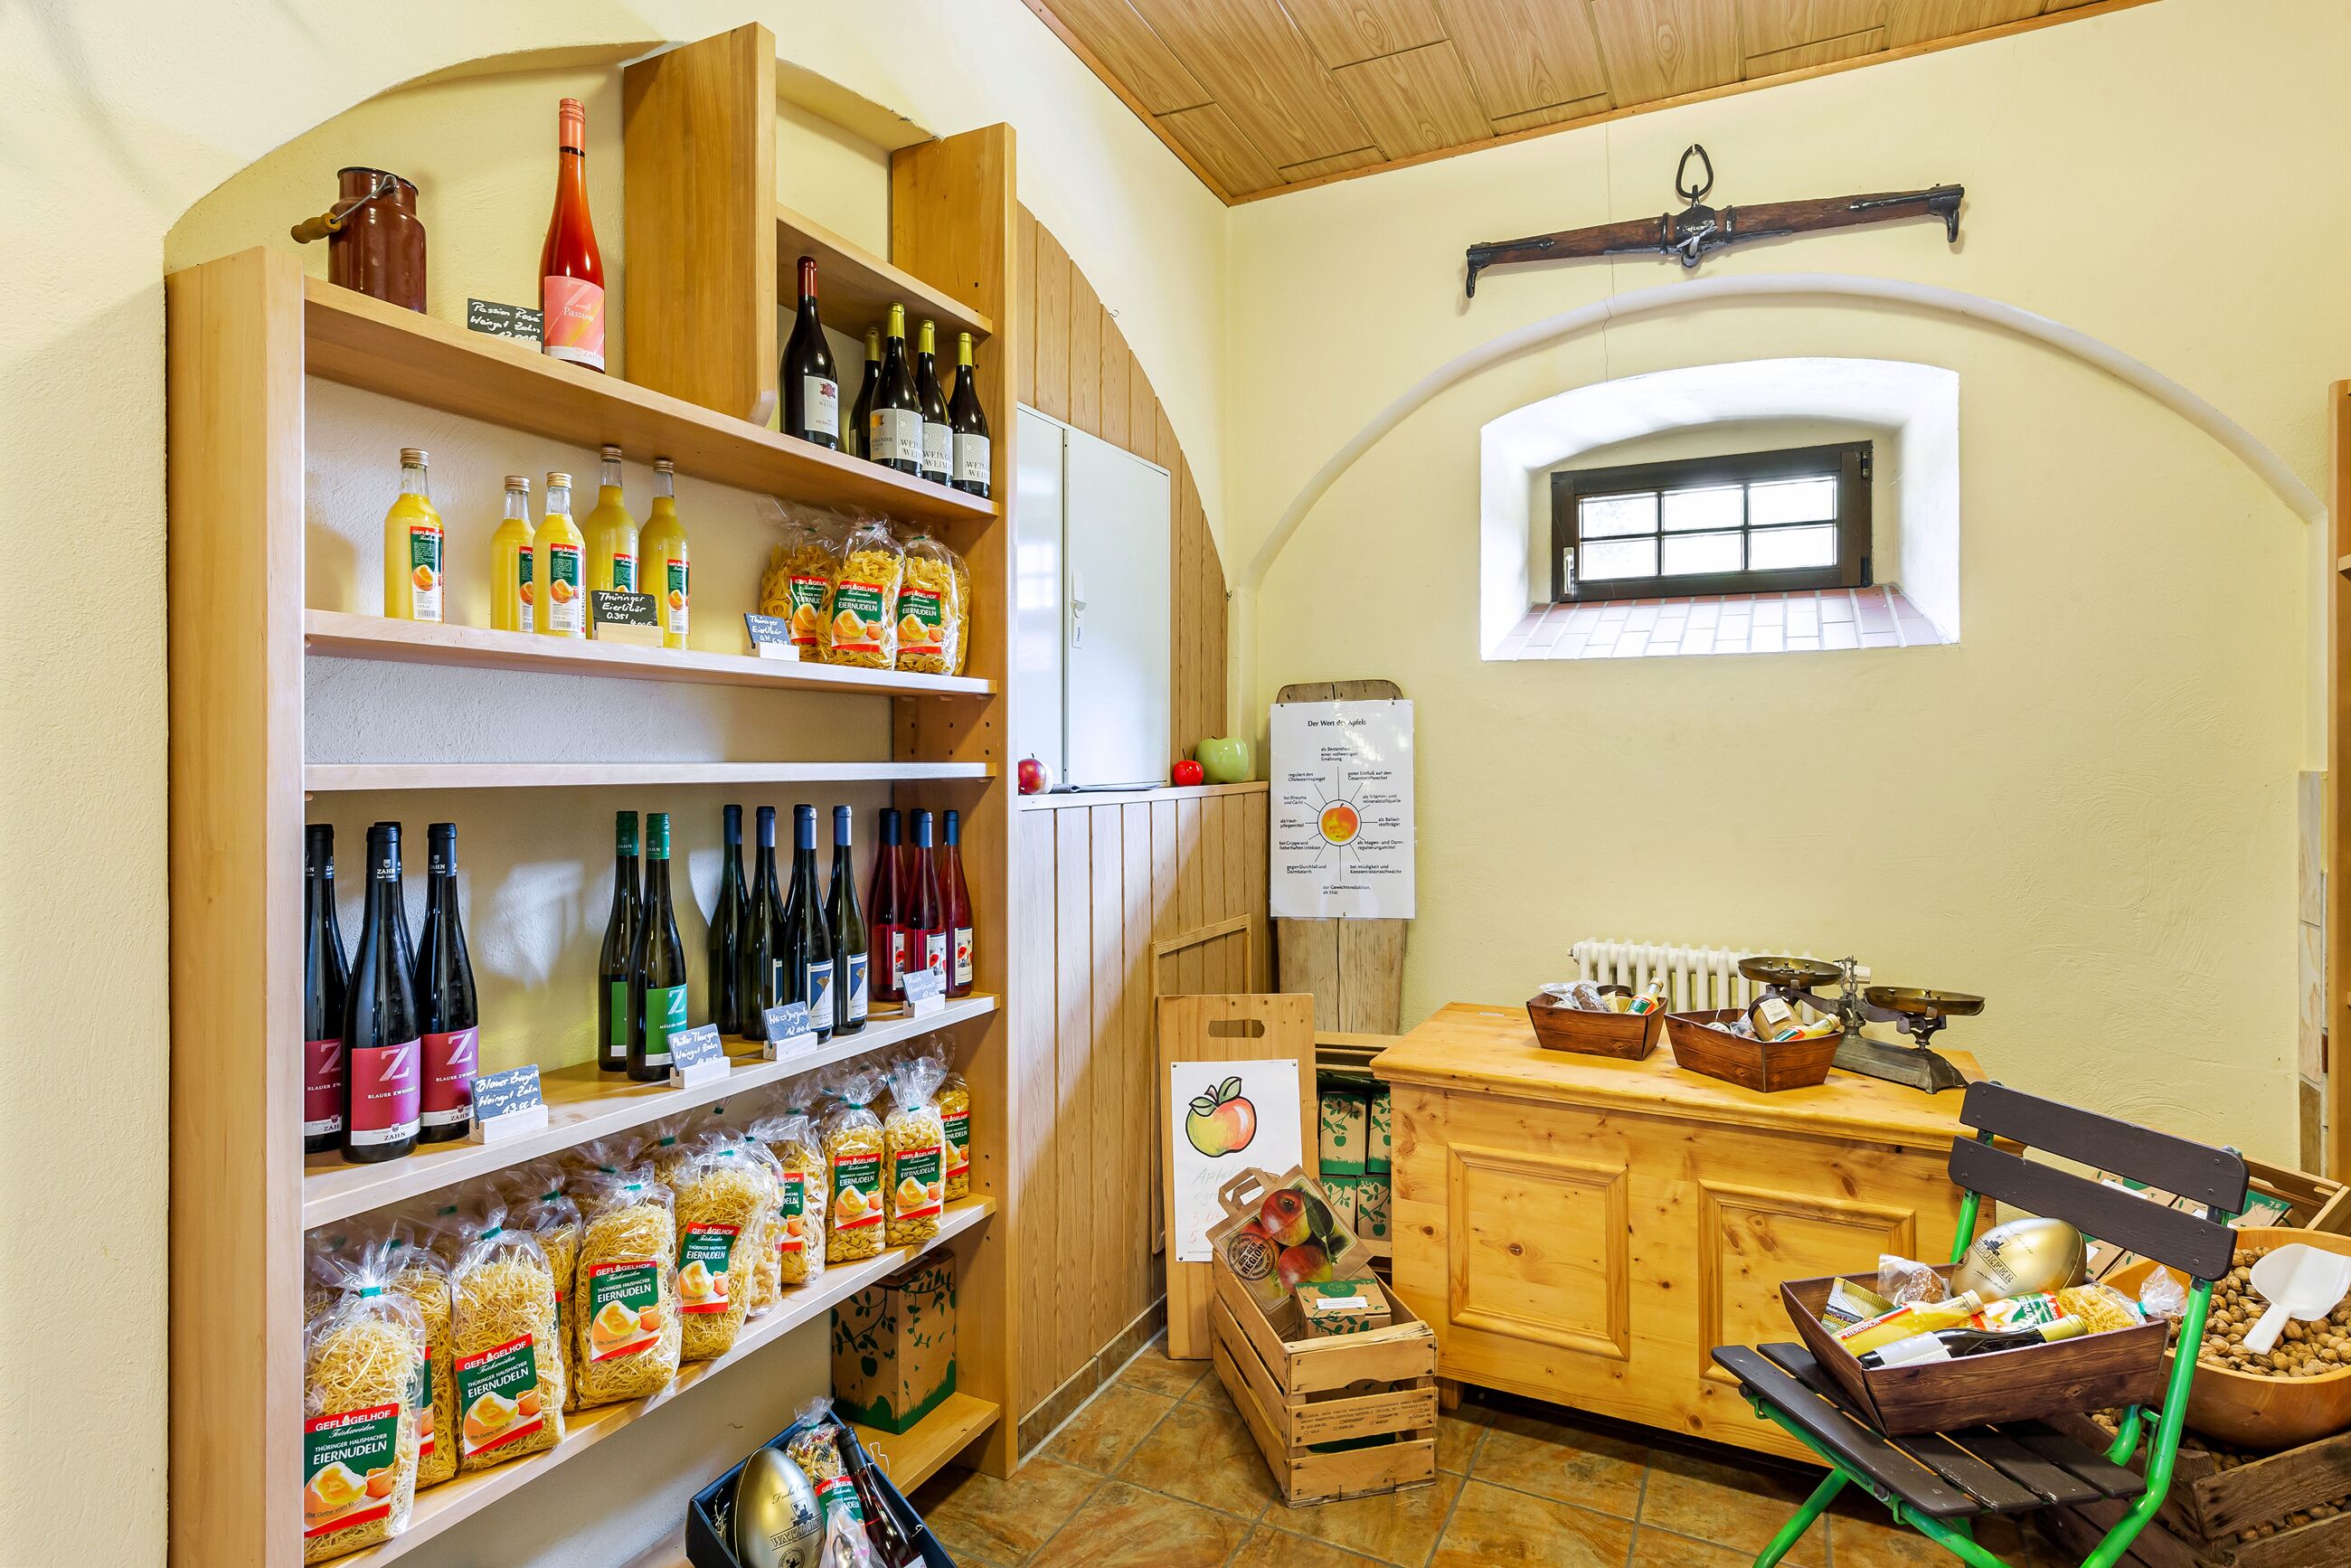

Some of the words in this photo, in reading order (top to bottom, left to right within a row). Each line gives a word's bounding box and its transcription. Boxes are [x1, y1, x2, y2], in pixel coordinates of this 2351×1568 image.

[472, 302, 510, 316] Passion
[515, 307, 543, 323] Rosé
[563, 307, 594, 322] Passion
[469, 316, 510, 331] Weingut
[514, 322, 541, 334] Zahn
[599, 591, 645, 605] Thüringer
[602, 602, 647, 613] Eierlikör
[838, 602, 878, 611] EIERNUDELN
[902, 608, 937, 617] EIERNUDELN
[1348, 719, 1366, 727] Apfels
[668, 987, 685, 1015] Z
[447, 1032, 472, 1065] Z
[675, 1048, 701, 1060] Weingut
[379, 1046, 410, 1082] Z
[477, 1091, 514, 1108] Weingut
[517, 1085, 538, 1097] Zahn
[450, 1113, 469, 1121] ZAHN
[324, 1123, 340, 1132] ZAH
[383, 1131, 406, 1141] ZAHN
[901, 1167, 936, 1178] EIERNUDELN
[839, 1176, 875, 1186] EIERNUDELN
[686, 1251, 725, 1260] EIERNUDELN
[1238, 1254, 1248, 1267] AUS
[1247, 1242, 1257, 1255] DER
[1241, 1243, 1267, 1275] REGION
[598, 1284, 622, 1293] THÜRINGER
[622, 1278, 650, 1288] HAUSMACHER
[598, 1284, 651, 1303] EIERNUDELN
[1846, 1318, 1881, 1337] EIERLIKÖR
[467, 1374, 496, 1388] THÜRINGER
[496, 1360, 528, 1376] HAUSMACHER
[467, 1367, 529, 1398] EIERNUDELN
[328, 1423, 375, 1438] Teichweiden
[316, 1441, 347, 1452] THÜRINGER
[349, 1433, 387, 1445] HAUSMACHER
[313, 1440, 387, 1465] EIERNUDELN
